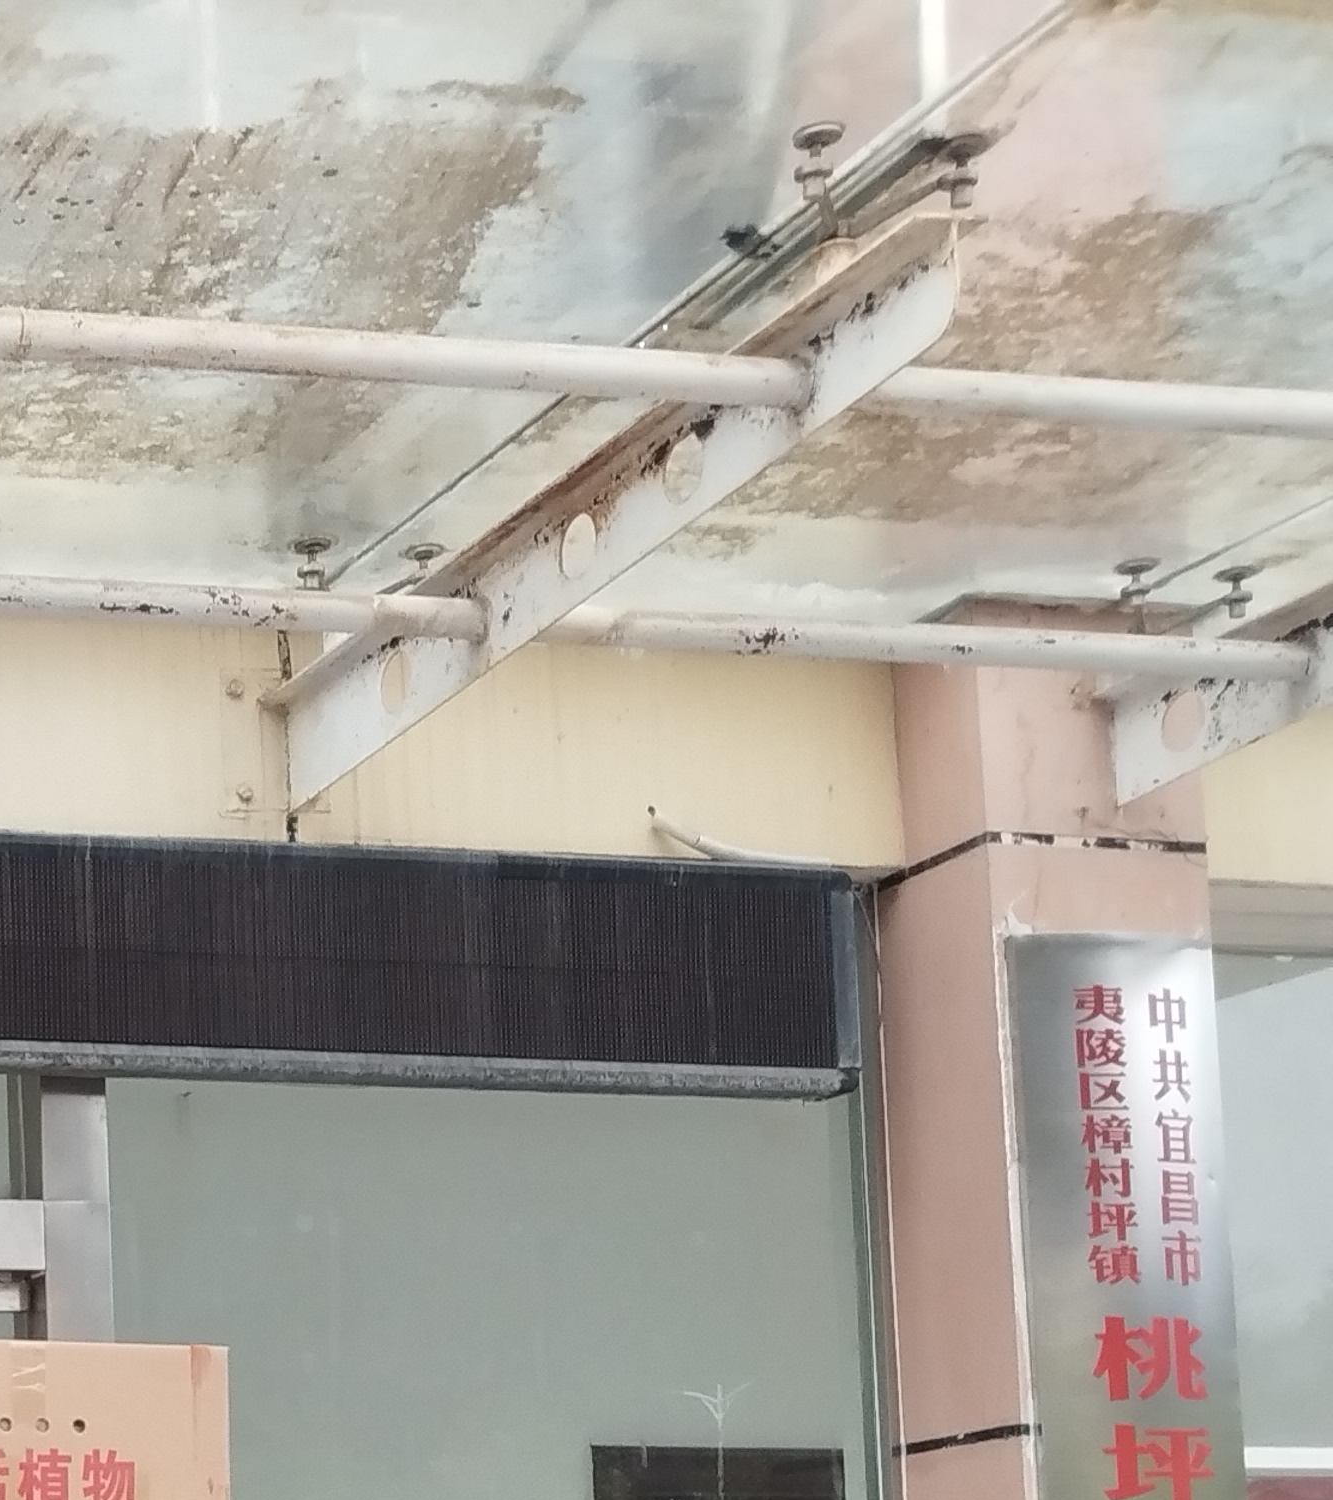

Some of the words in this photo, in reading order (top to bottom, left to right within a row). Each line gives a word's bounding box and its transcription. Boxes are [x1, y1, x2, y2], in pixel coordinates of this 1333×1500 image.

[1072, 984, 1142, 1286] 夷陵区樟村坪镇
[1147, 987, 1202, 1287] 中共宜昌市
